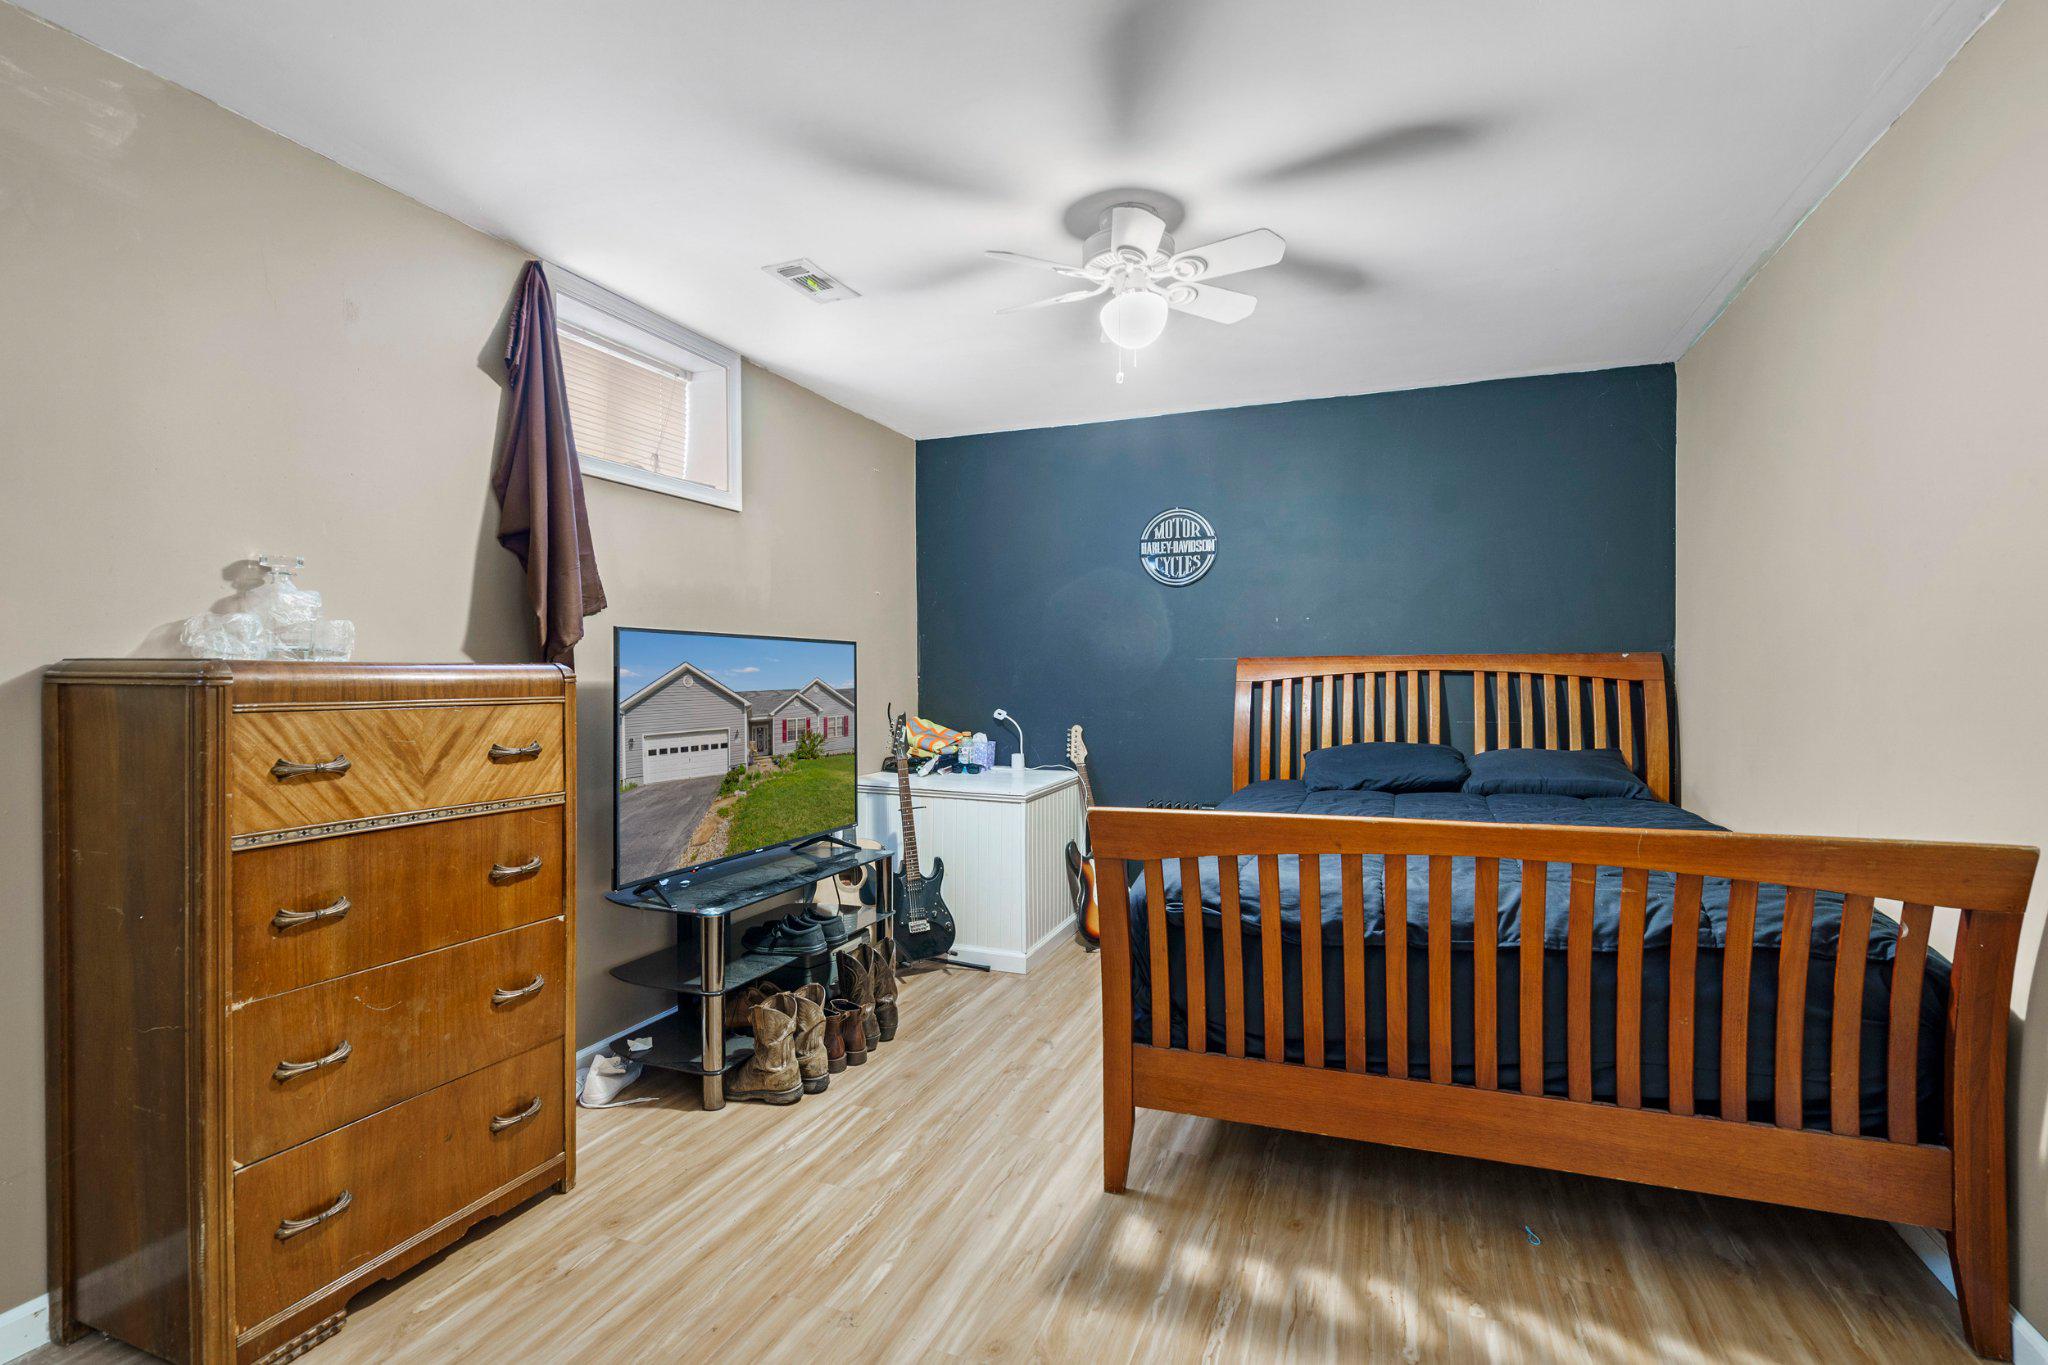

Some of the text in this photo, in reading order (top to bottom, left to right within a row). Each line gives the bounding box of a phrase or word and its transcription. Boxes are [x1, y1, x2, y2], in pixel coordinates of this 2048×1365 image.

[1154, 517, 1202, 539] MOTOR
[1141, 540, 1215, 555] HARLEY-DAVIDSON
[1154, 555, 1201, 577] CYCLES
